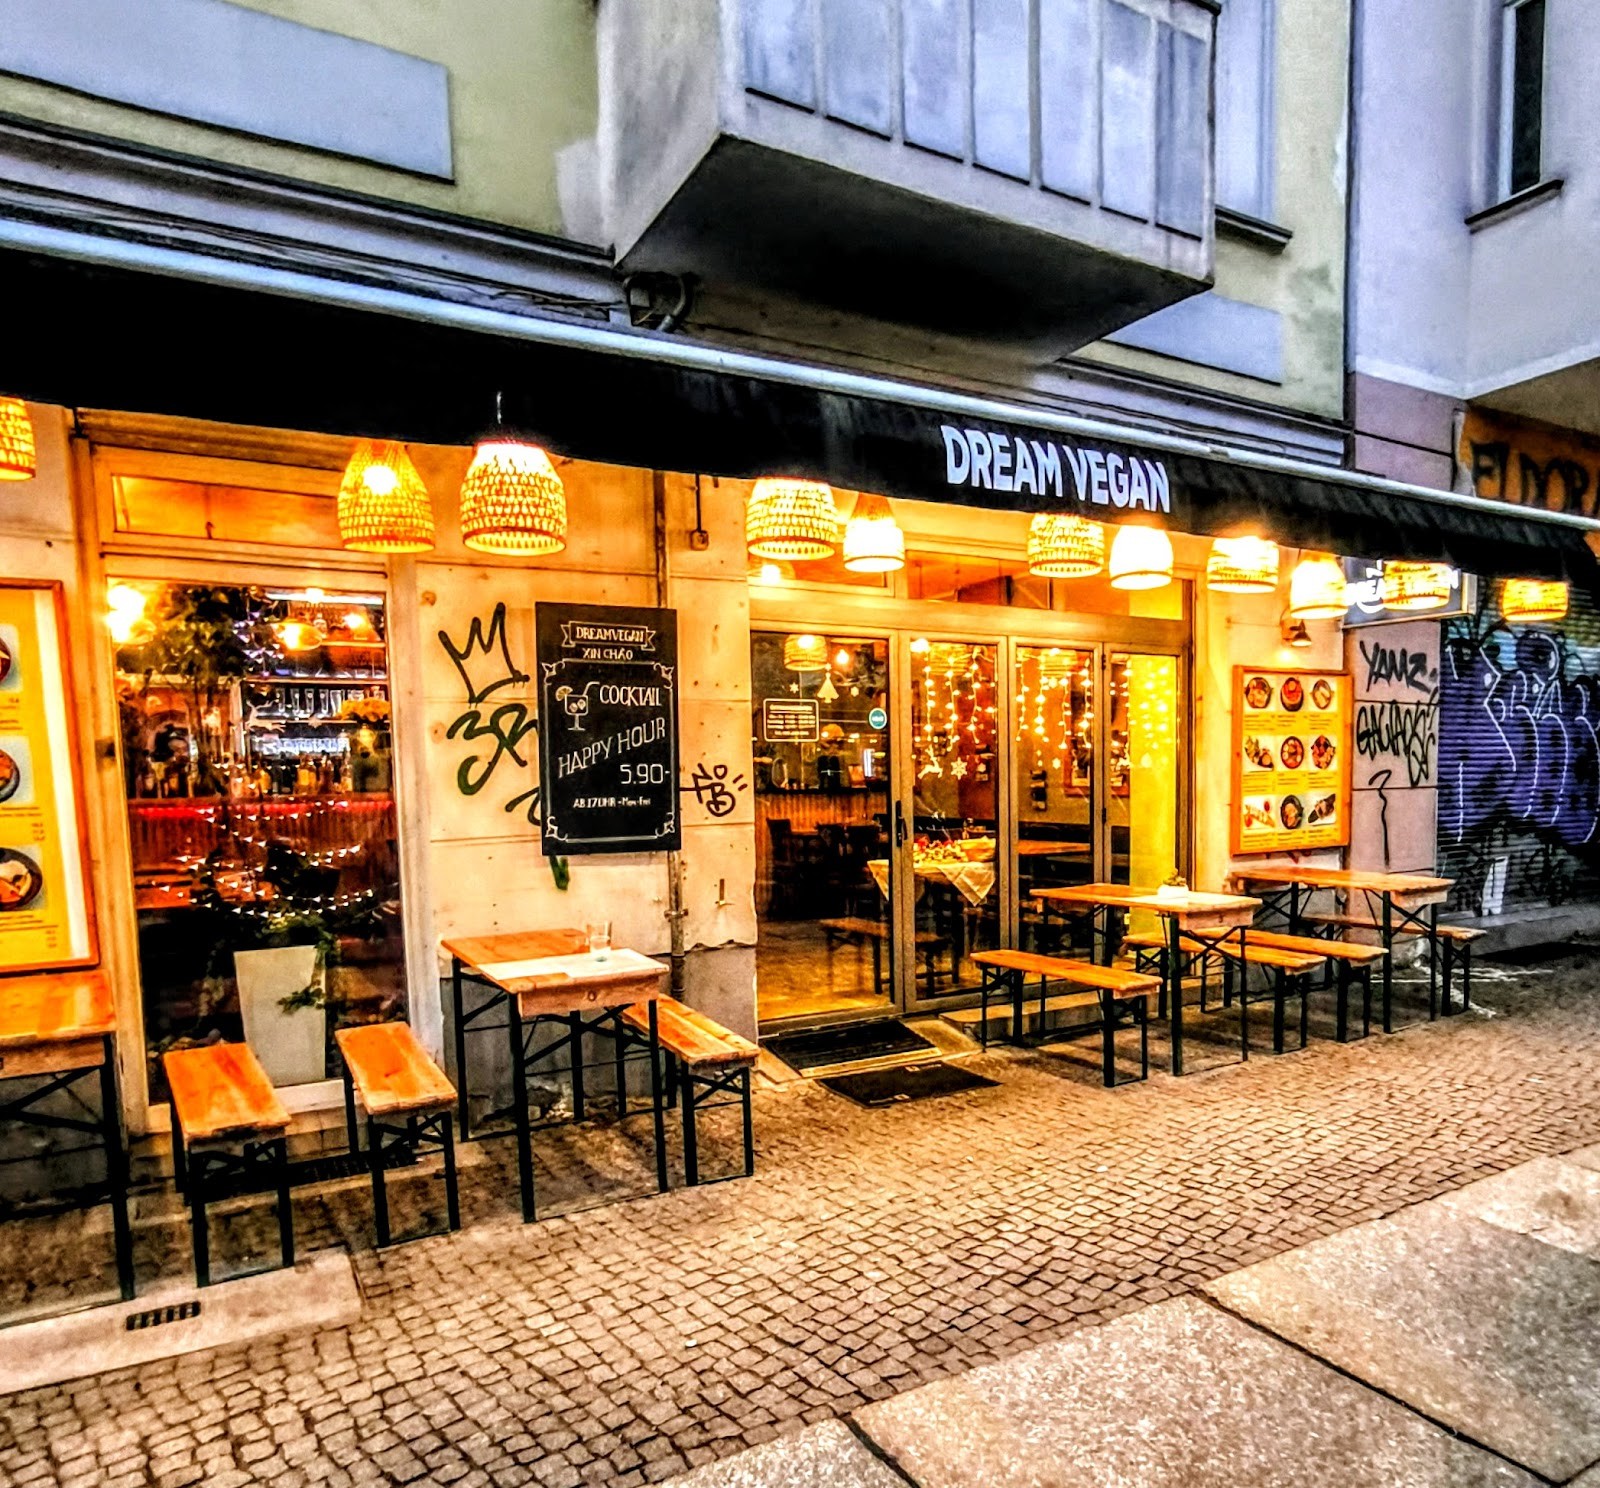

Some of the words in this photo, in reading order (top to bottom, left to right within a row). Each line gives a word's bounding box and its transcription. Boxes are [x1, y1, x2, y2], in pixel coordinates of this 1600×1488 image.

[940, 425, 1063, 497] DREAM
[1062, 445, 1170, 513] VEGAN
[576, 626, 644, 642] DREAMVEGAN
[582, 647, 601, 659] XIN
[599, 684, 662, 707] COCKTAIL
[558, 734, 612, 779] HAPPY
[616, 717, 666, 754] HOUR
